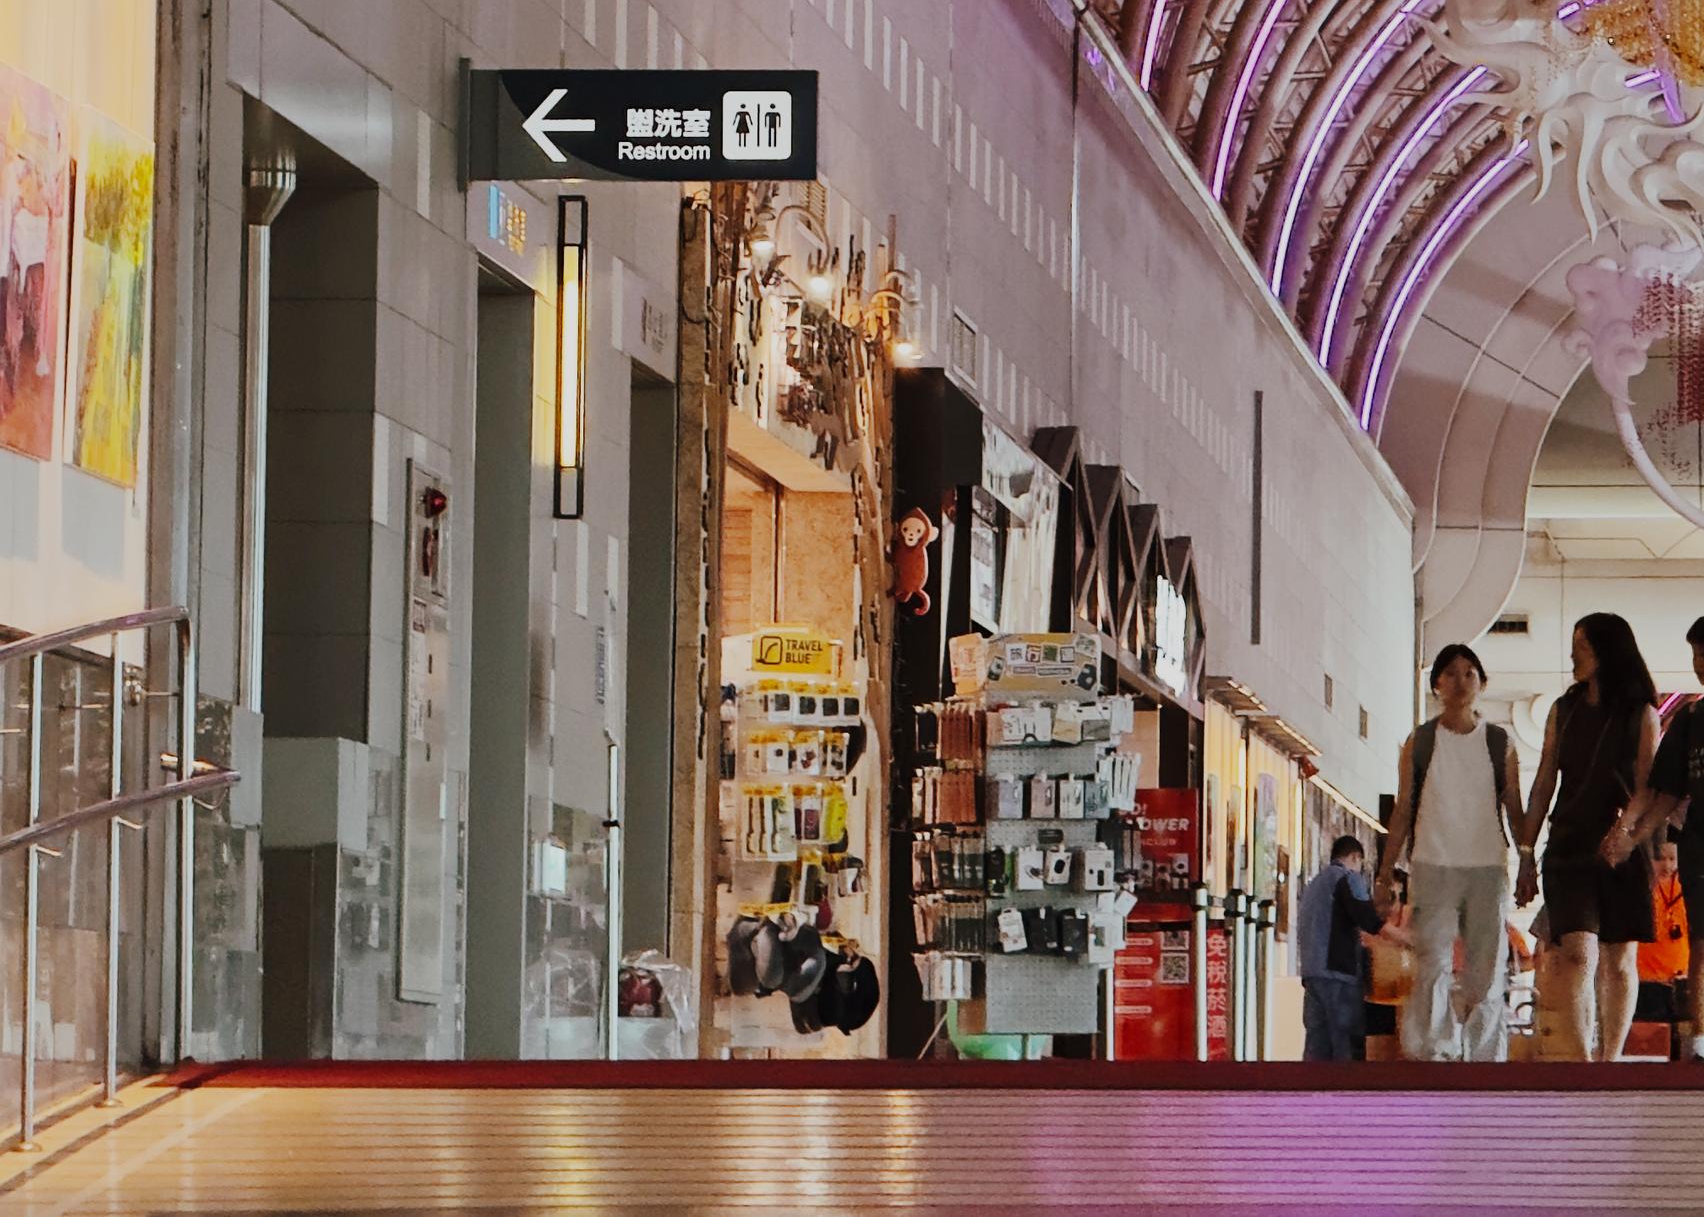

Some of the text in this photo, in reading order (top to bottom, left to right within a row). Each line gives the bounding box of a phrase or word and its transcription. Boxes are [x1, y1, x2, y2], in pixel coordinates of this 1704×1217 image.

[626, 108, 711, 137] 盥洗室
[618, 142, 711, 160] Restroom
[785, 639, 823, 652] TRAVEL
[785, 653, 811, 664] BLUE
[1139, 817, 1190, 832] OWER
